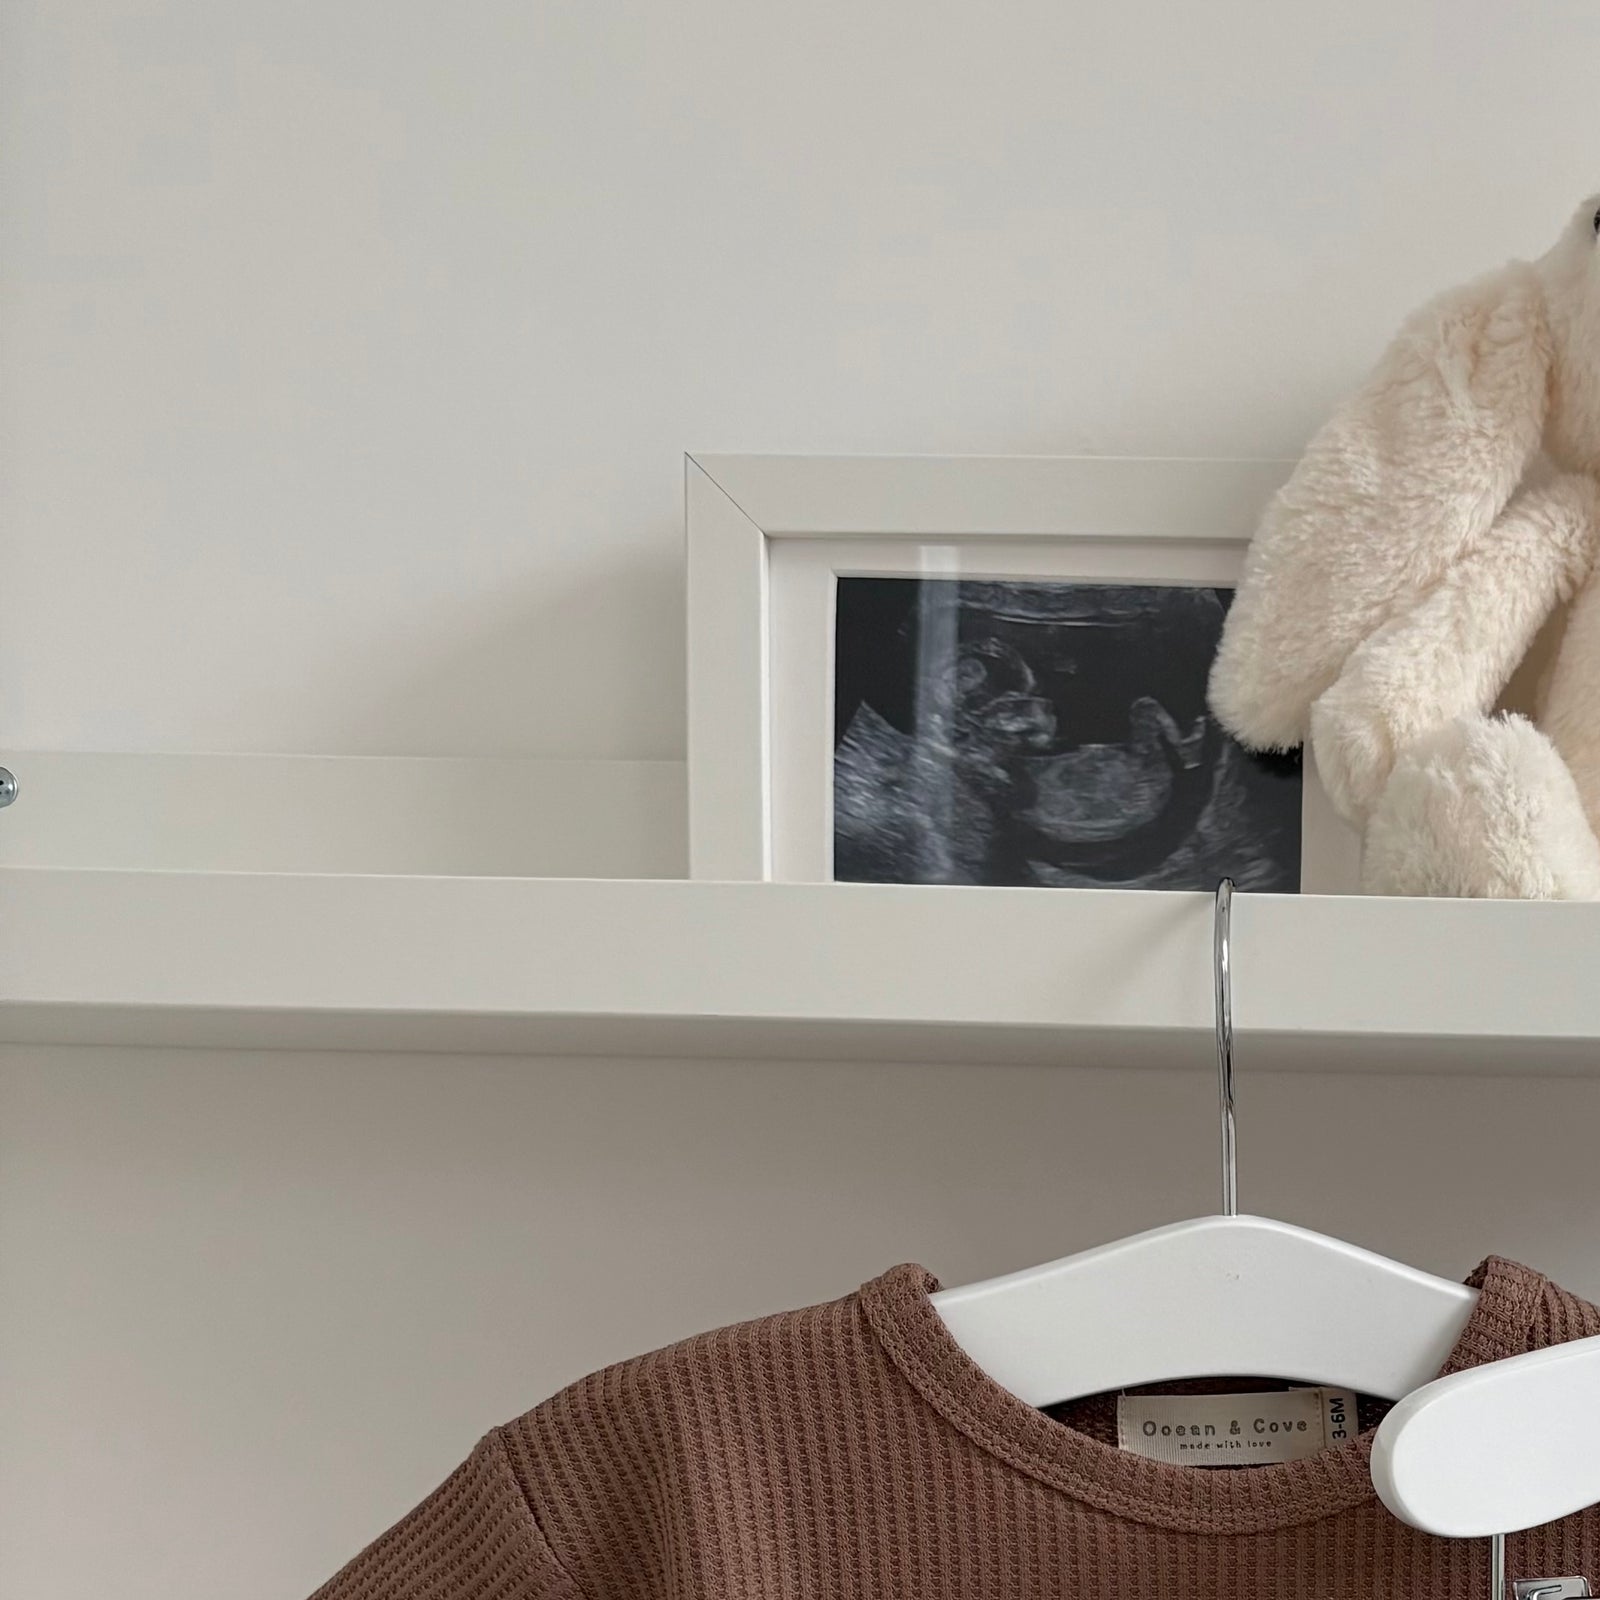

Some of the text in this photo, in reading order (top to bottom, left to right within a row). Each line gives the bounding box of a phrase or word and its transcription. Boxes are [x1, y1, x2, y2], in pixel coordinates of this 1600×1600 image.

[1229, 1419, 1241, 1435] &
[1253, 1418, 1308, 1434] Cove
[1329, 1397, 1347, 1440] 3-6M
[1179, 1440, 1272, 1450] made with love
